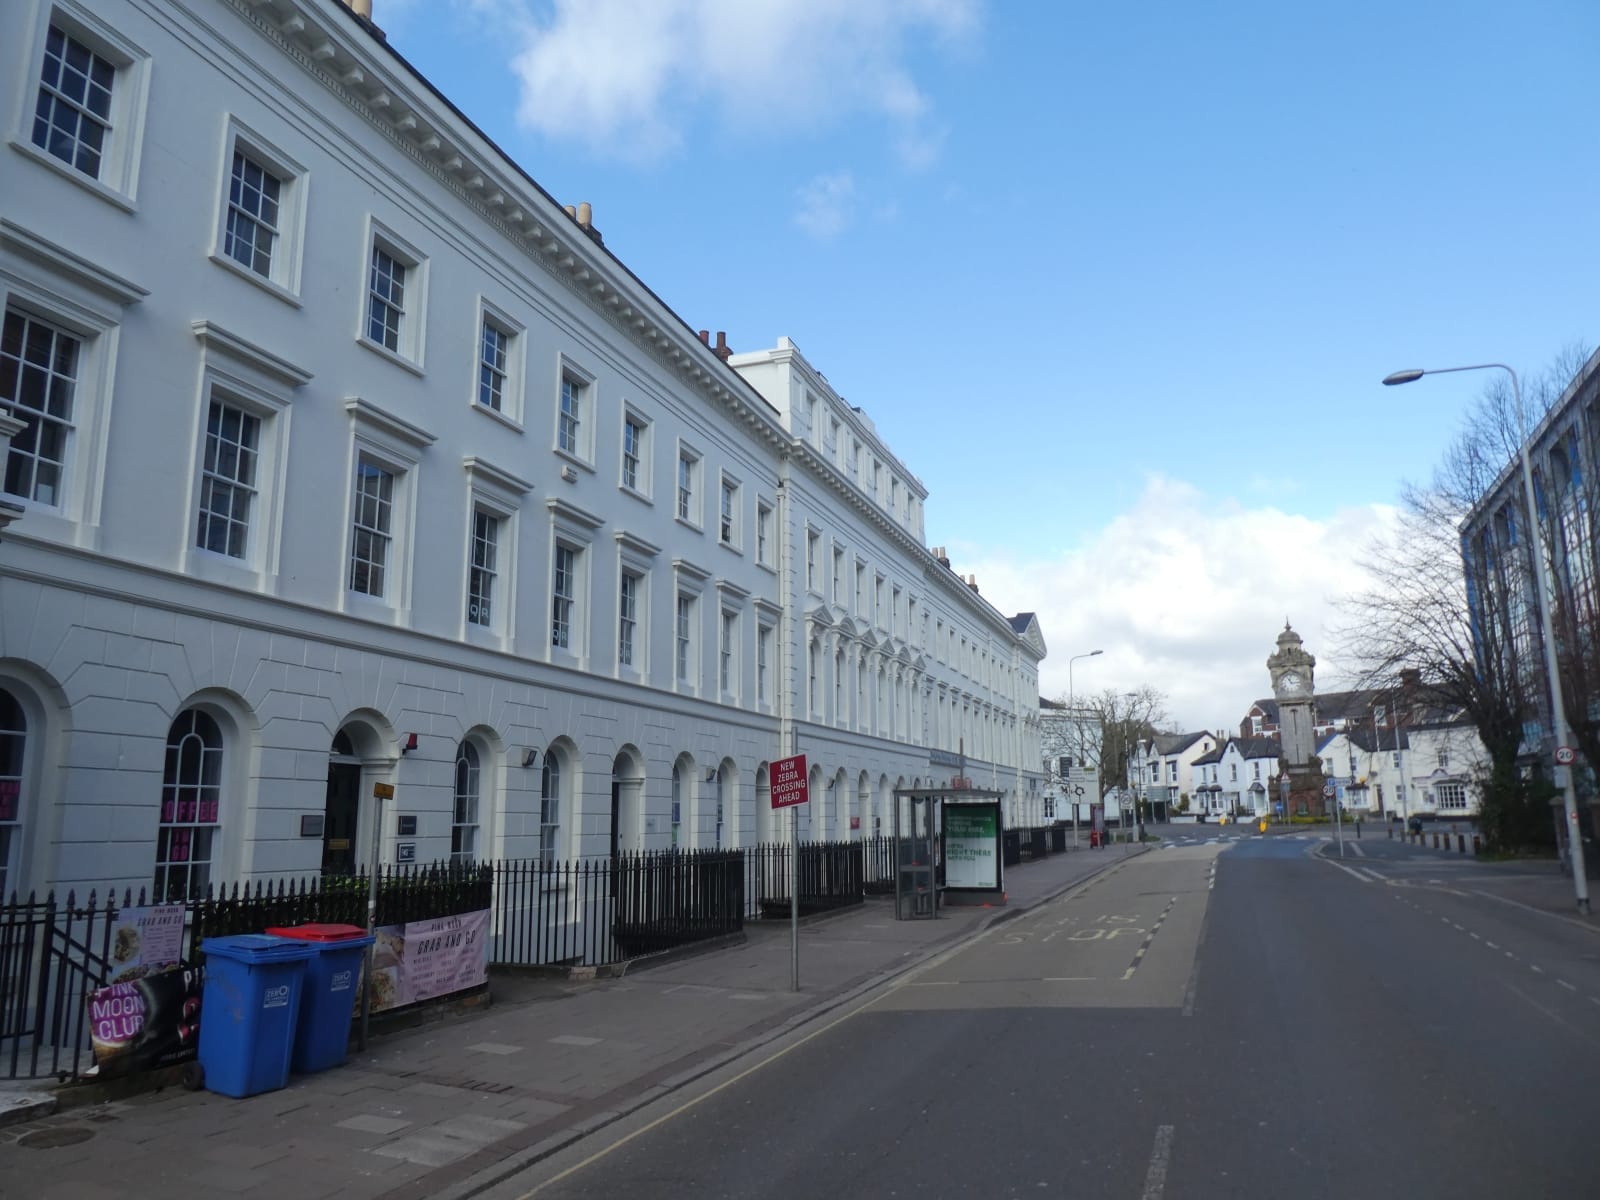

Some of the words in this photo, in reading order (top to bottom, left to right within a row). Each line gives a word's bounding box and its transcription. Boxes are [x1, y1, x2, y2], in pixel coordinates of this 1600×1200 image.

[1559, 751, 1572, 760] 20
[780, 760, 795, 772] NEW
[778, 770, 798, 783] ZEBRA
[772, 779, 806, 795] CROSSING
[778, 791, 800, 804] AHEAD
[163, 800, 217, 822] OFFEE
[417, 937, 442, 956] GRAB
[445, 933, 462, 949] AND
[465, 929, 477, 945] GO
[994, 927, 1146, 944] STOP
[92, 994, 146, 1020] MOON
